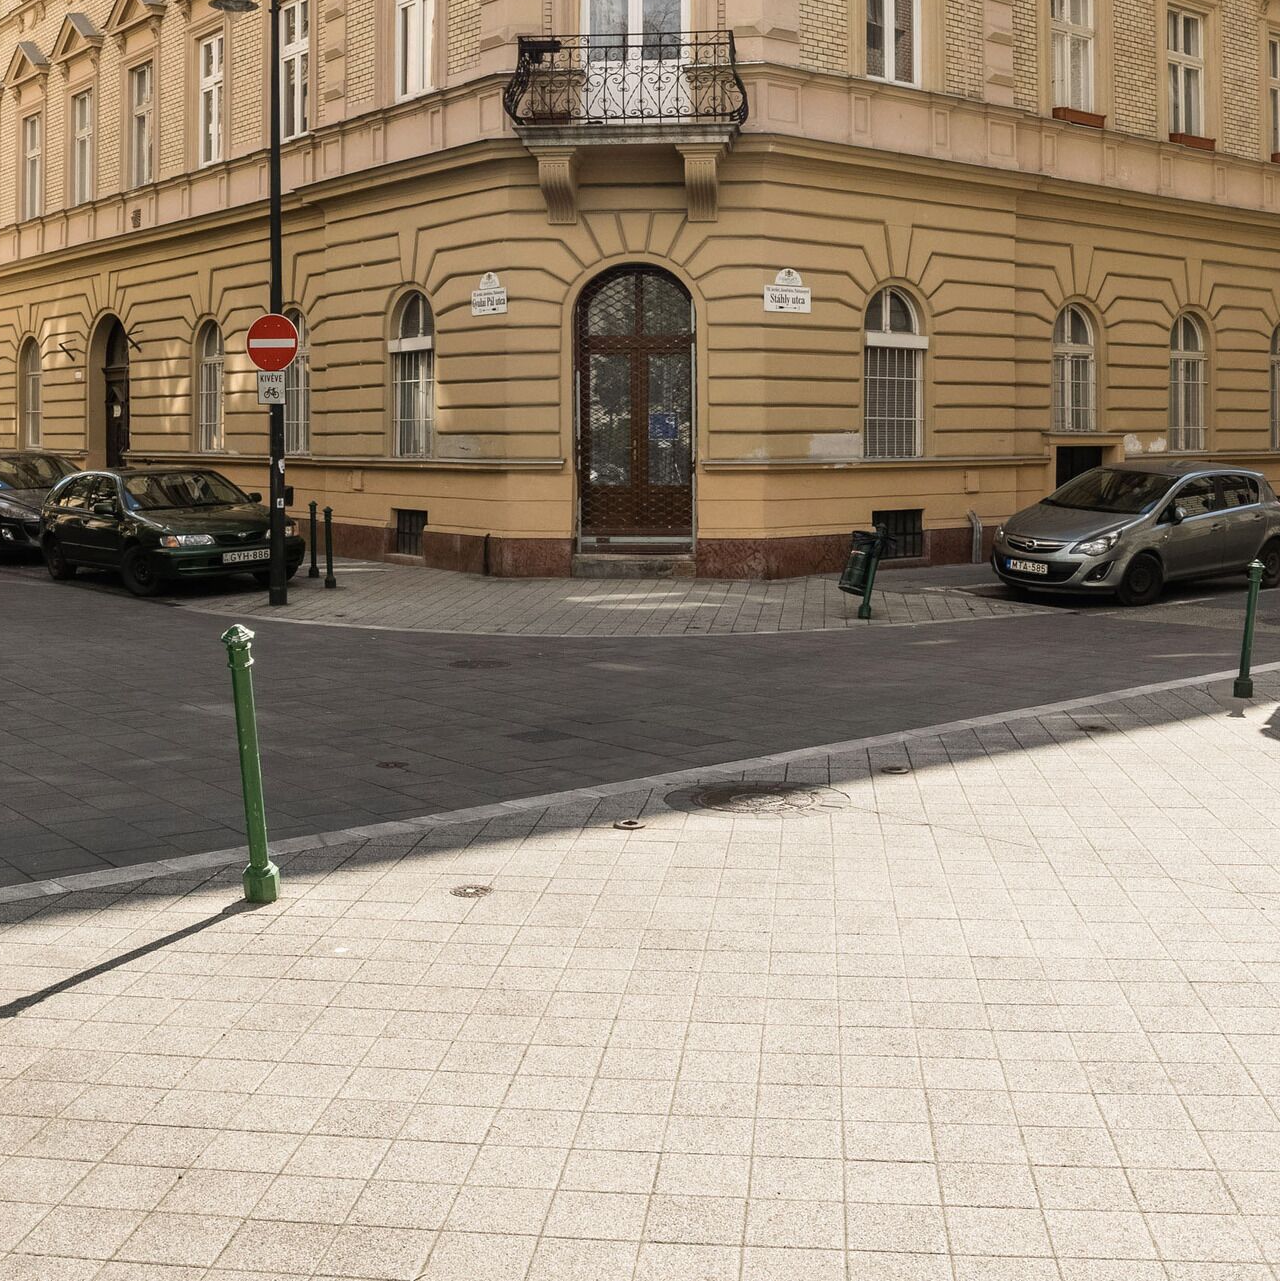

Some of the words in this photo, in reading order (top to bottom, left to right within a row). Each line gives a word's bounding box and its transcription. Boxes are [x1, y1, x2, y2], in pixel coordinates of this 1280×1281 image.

[791, 296, 806, 305] utca
[260, 373, 283, 383] KIVÉVE
[230, 550, 269, 562] GYH-886
[1012, 560, 1046, 573] MTA-585
